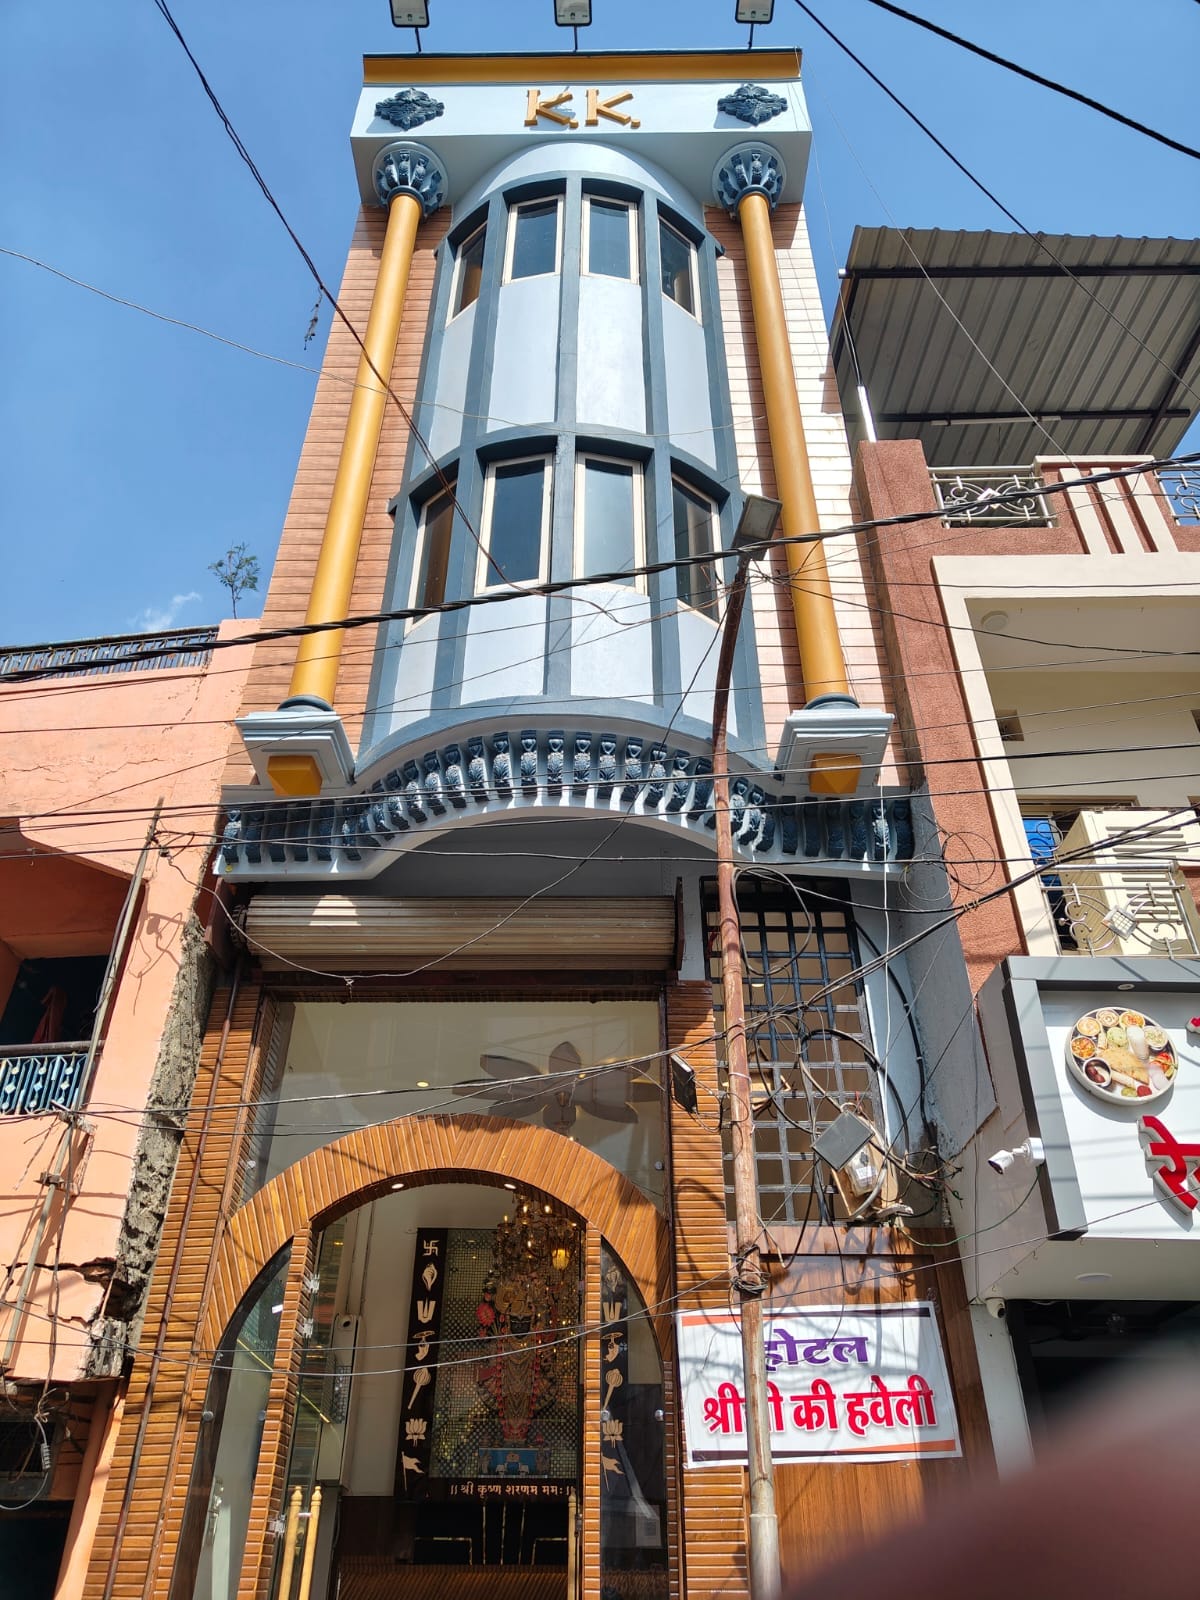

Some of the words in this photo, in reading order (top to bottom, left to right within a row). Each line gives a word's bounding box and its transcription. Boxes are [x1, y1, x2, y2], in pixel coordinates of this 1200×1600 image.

[704, 1382, 785, 1433] श्रीी
[791, 1379, 838, 1430] की
[843, 1374, 938, 1436] हवेली
